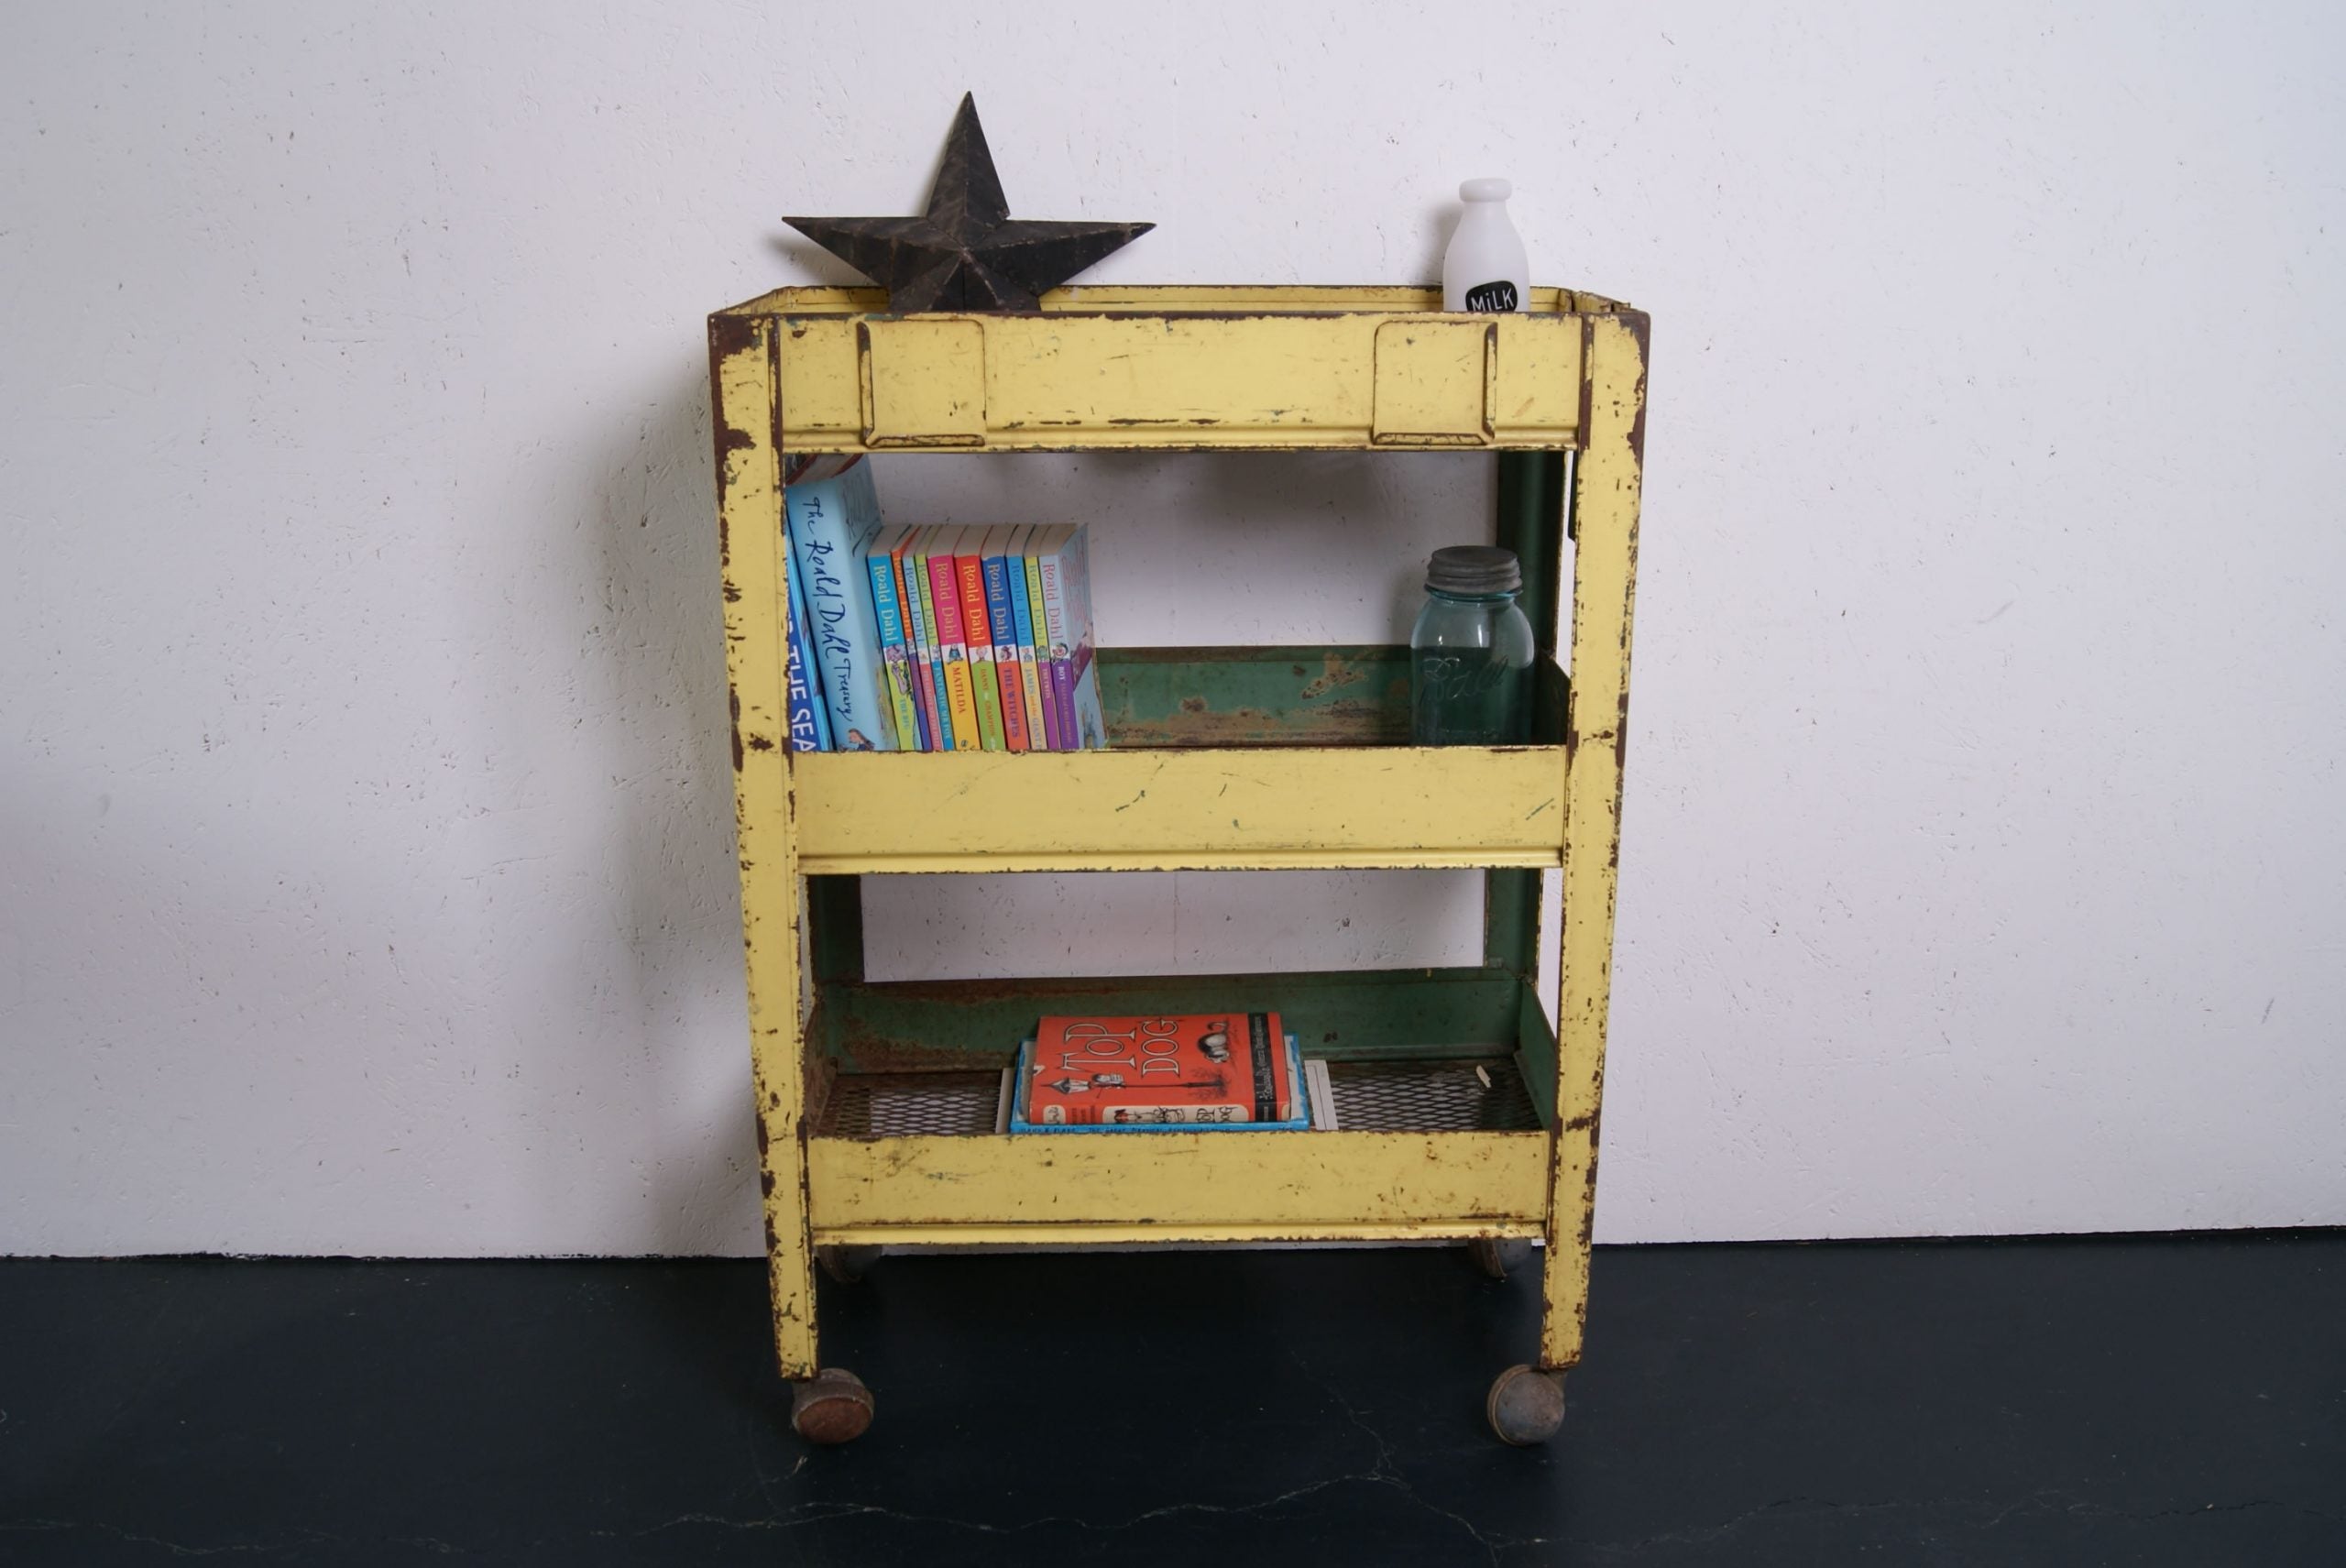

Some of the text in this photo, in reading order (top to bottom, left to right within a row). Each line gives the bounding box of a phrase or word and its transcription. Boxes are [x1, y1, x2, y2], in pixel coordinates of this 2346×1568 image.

[803, 497, 853, 722] The Roald Dahl Treasury
[873, 565, 898, 641] Roald Dahl
[905, 567, 918, 603] Roald
[913, 610, 925, 641] Dahl
[918, 565, 937, 639] Roald Dahl
[936, 563, 958, 639] Roald Dahl
[963, 565, 985, 641] Roald Dahl
[988, 564, 1010, 640] Roald Dahl
[1011, 565, 1029, 640] Roald Dahl
[1042, 565, 1064, 639] Roald Dahl
[953, 667, 966, 714] MATILDA
[1004, 669, 1020, 738] THE WITCHES
[1025, 669, 1035, 695] JAMES
[792, 708, 817, 751] SEA
[1059, 1022, 1137, 1072] TOP
[1140, 1017, 1180, 1078] DOG
